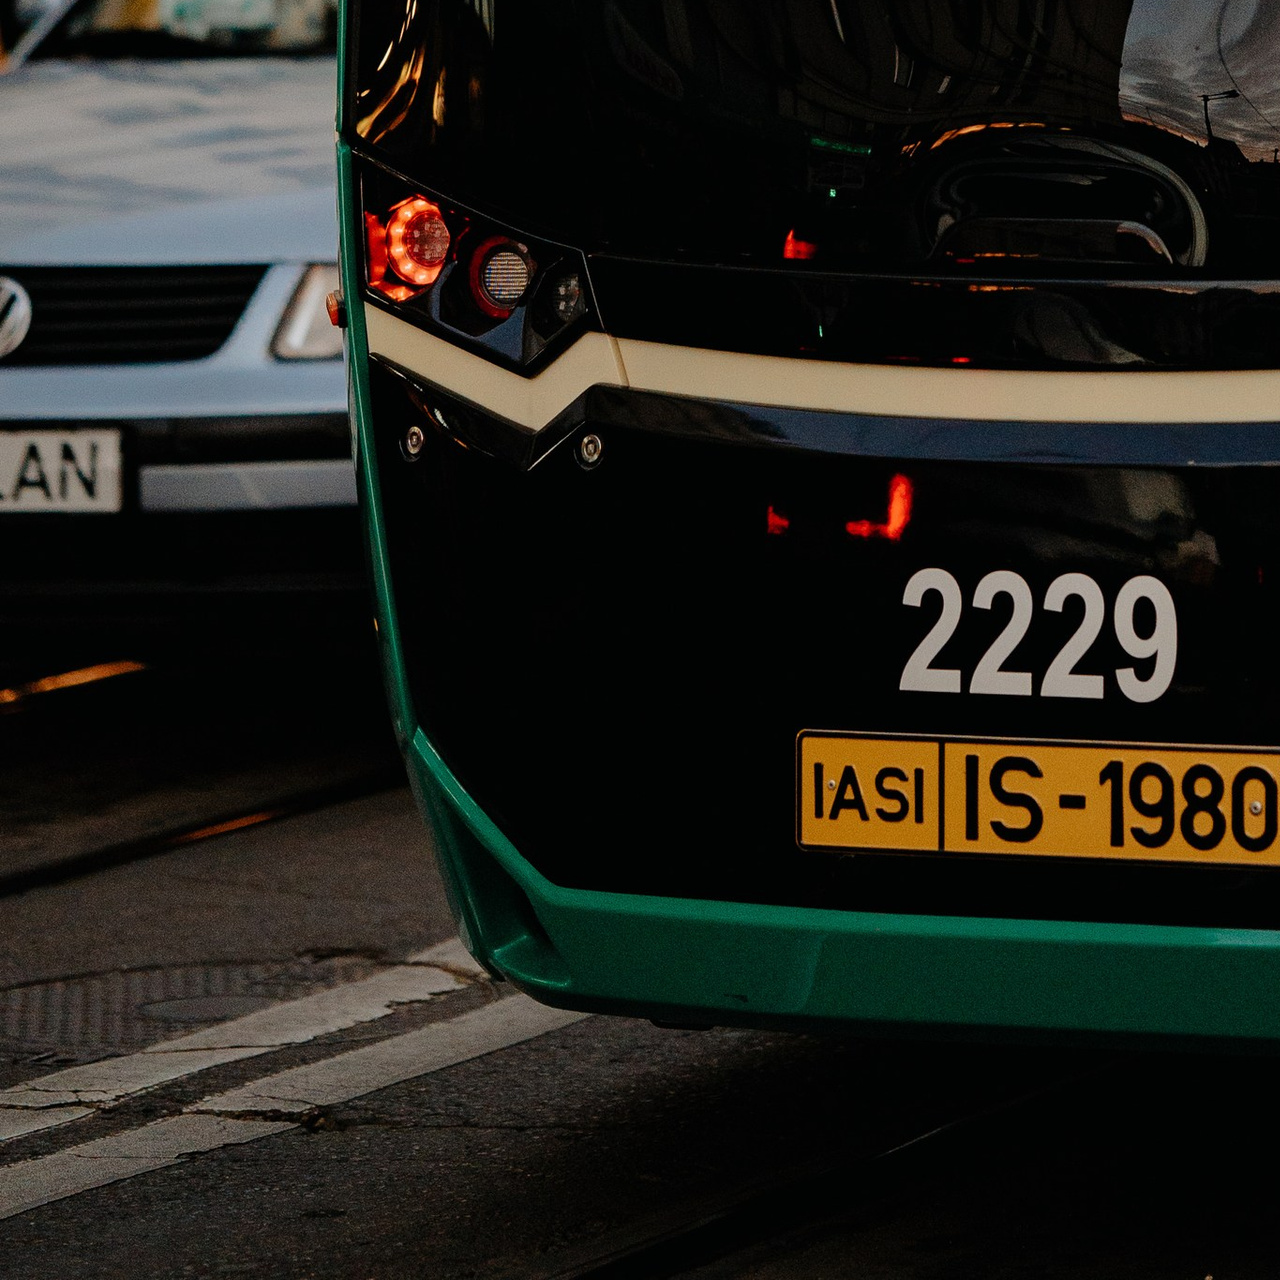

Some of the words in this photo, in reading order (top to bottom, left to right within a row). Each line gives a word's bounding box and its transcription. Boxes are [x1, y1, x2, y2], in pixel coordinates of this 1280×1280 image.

[0, 442, 98, 501] AN
[900, 567, 1177, 703] 2229
[813, 762, 924, 824] IASI
[965, 754, 1278, 853] IS-1980
